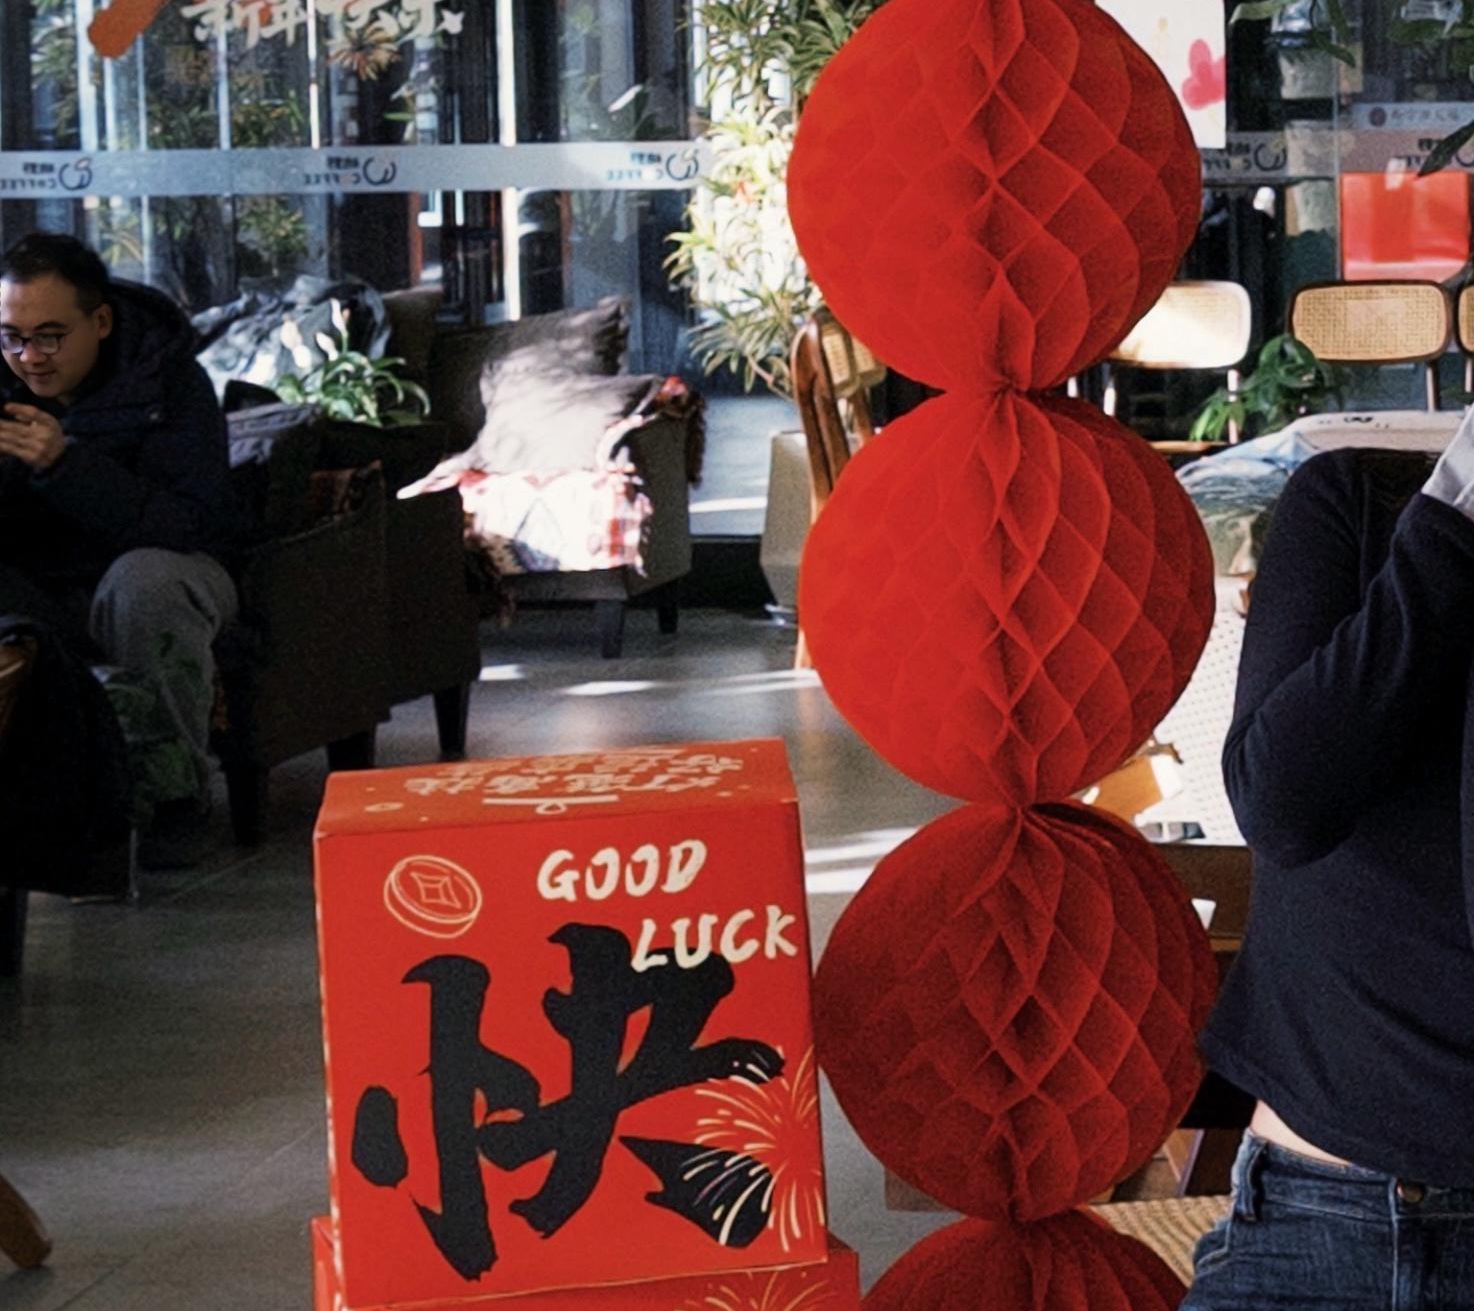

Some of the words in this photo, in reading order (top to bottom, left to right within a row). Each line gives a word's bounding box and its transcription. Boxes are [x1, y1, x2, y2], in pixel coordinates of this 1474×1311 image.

[537, 839, 707, 901] GOOD
[631, 905, 798, 973] LUCK
[351, 922, 786, 1282] 快
